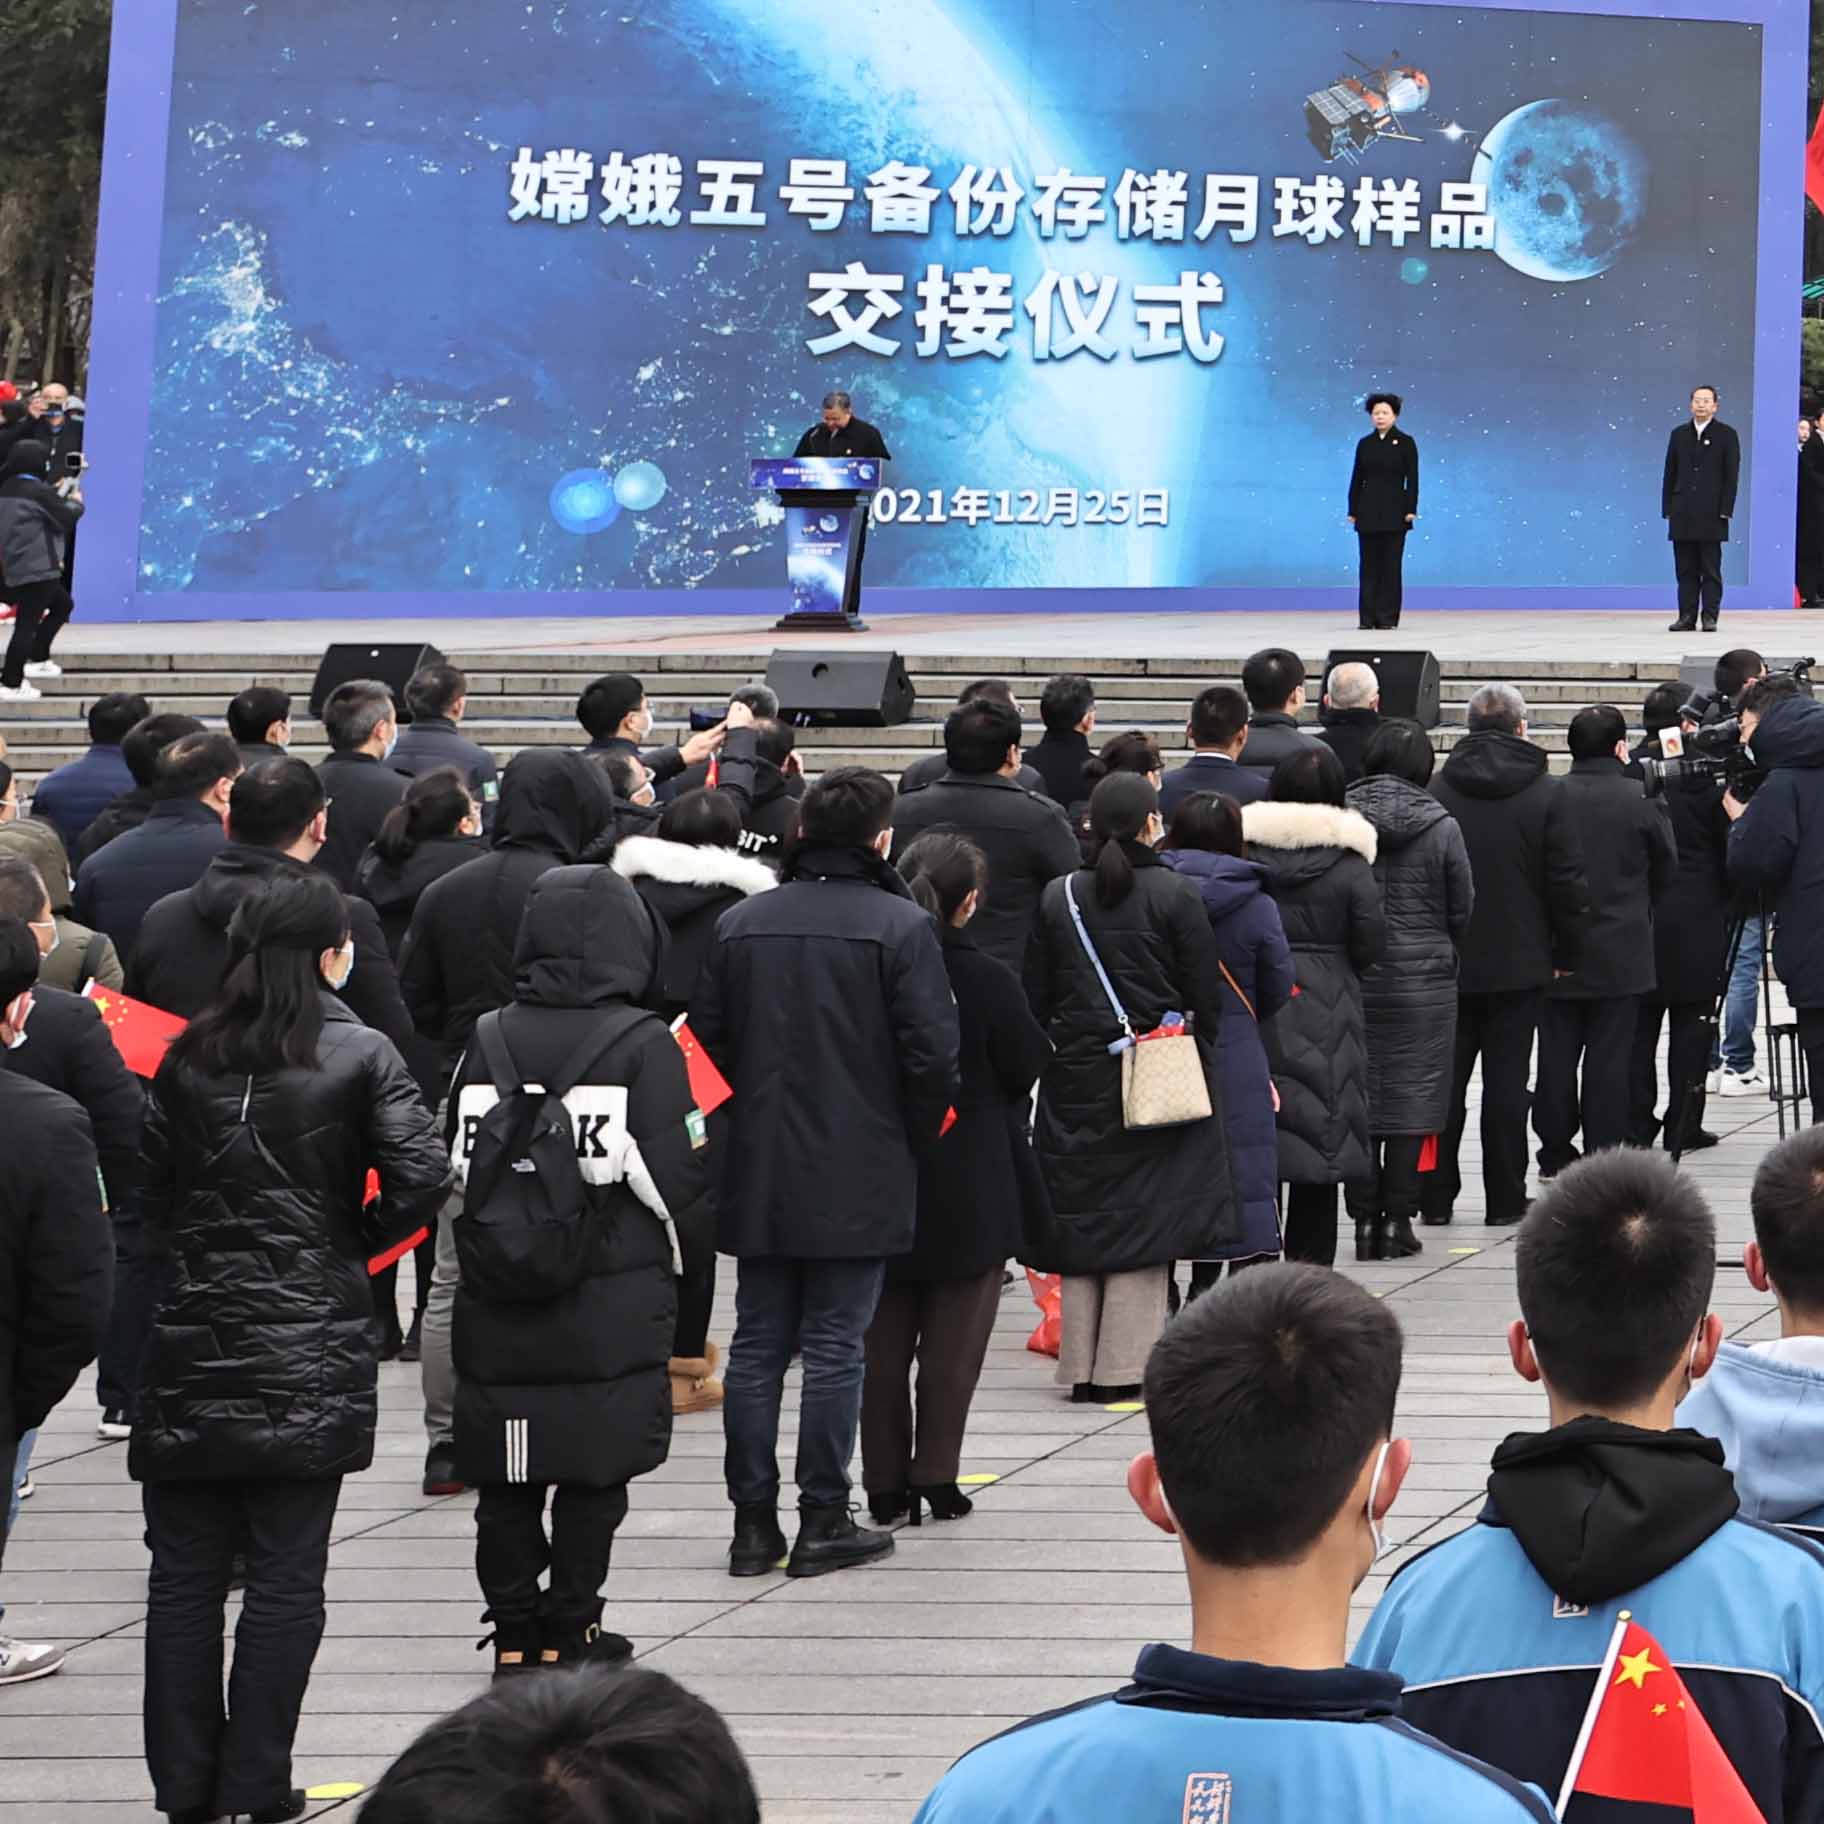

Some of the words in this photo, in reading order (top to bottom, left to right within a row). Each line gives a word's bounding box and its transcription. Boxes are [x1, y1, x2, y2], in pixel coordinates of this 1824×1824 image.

[507, 146, 1496, 250] 嫦娥五号备份存储月球样品
[805, 261, 1225, 363] 交接仪式
[871, 485, 1170, 527] 021年12月25日
